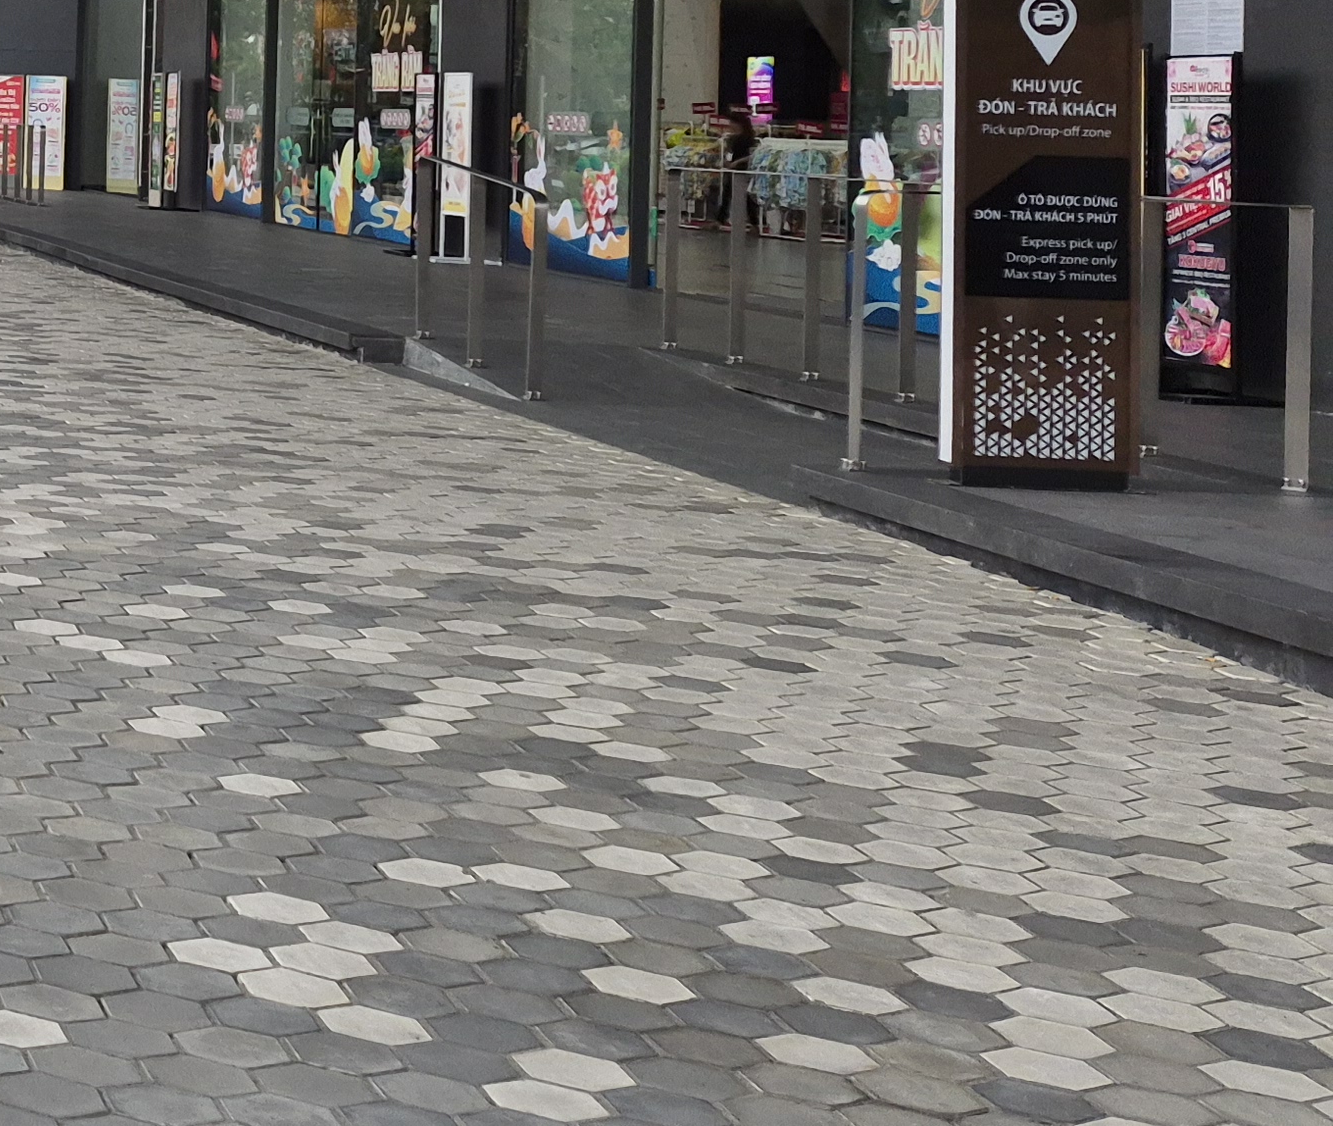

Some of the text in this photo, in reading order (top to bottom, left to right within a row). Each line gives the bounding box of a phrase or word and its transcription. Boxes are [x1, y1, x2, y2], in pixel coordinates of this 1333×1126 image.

[890, 20, 943, 91] TRĂN
[1012, 78, 1083, 97] KHU VỰC
[1170, 81, 1232, 93] SUSHI WORLD
[28, 102, 61, 113] 50%
[978, 98, 1015, 115] ĐÓN
[1028, 97, 1058, 116] TRẢ
[1062, 100, 1117, 118] KHÁCH
[982, 124, 1112, 138] Pick up/Drop-off zone
[1018, 192, 1118, 209] Ô TÔ ĐƯỢC DỪNG
[974, 208, 1001, 220] ĐÓN
[1010, 208, 1032, 221] TRẢ
[1034, 210, 1075, 222] KHÁCH
[1077, 213, 1084, 223] 5
[1087, 211, 1118, 224] PHÚT
[1021, 236, 1118, 252] Express pick up/
[1006, 252, 1118, 268] Drop-off zone only
[1004, 269, 1117, 283] Max stay 5 minutes
